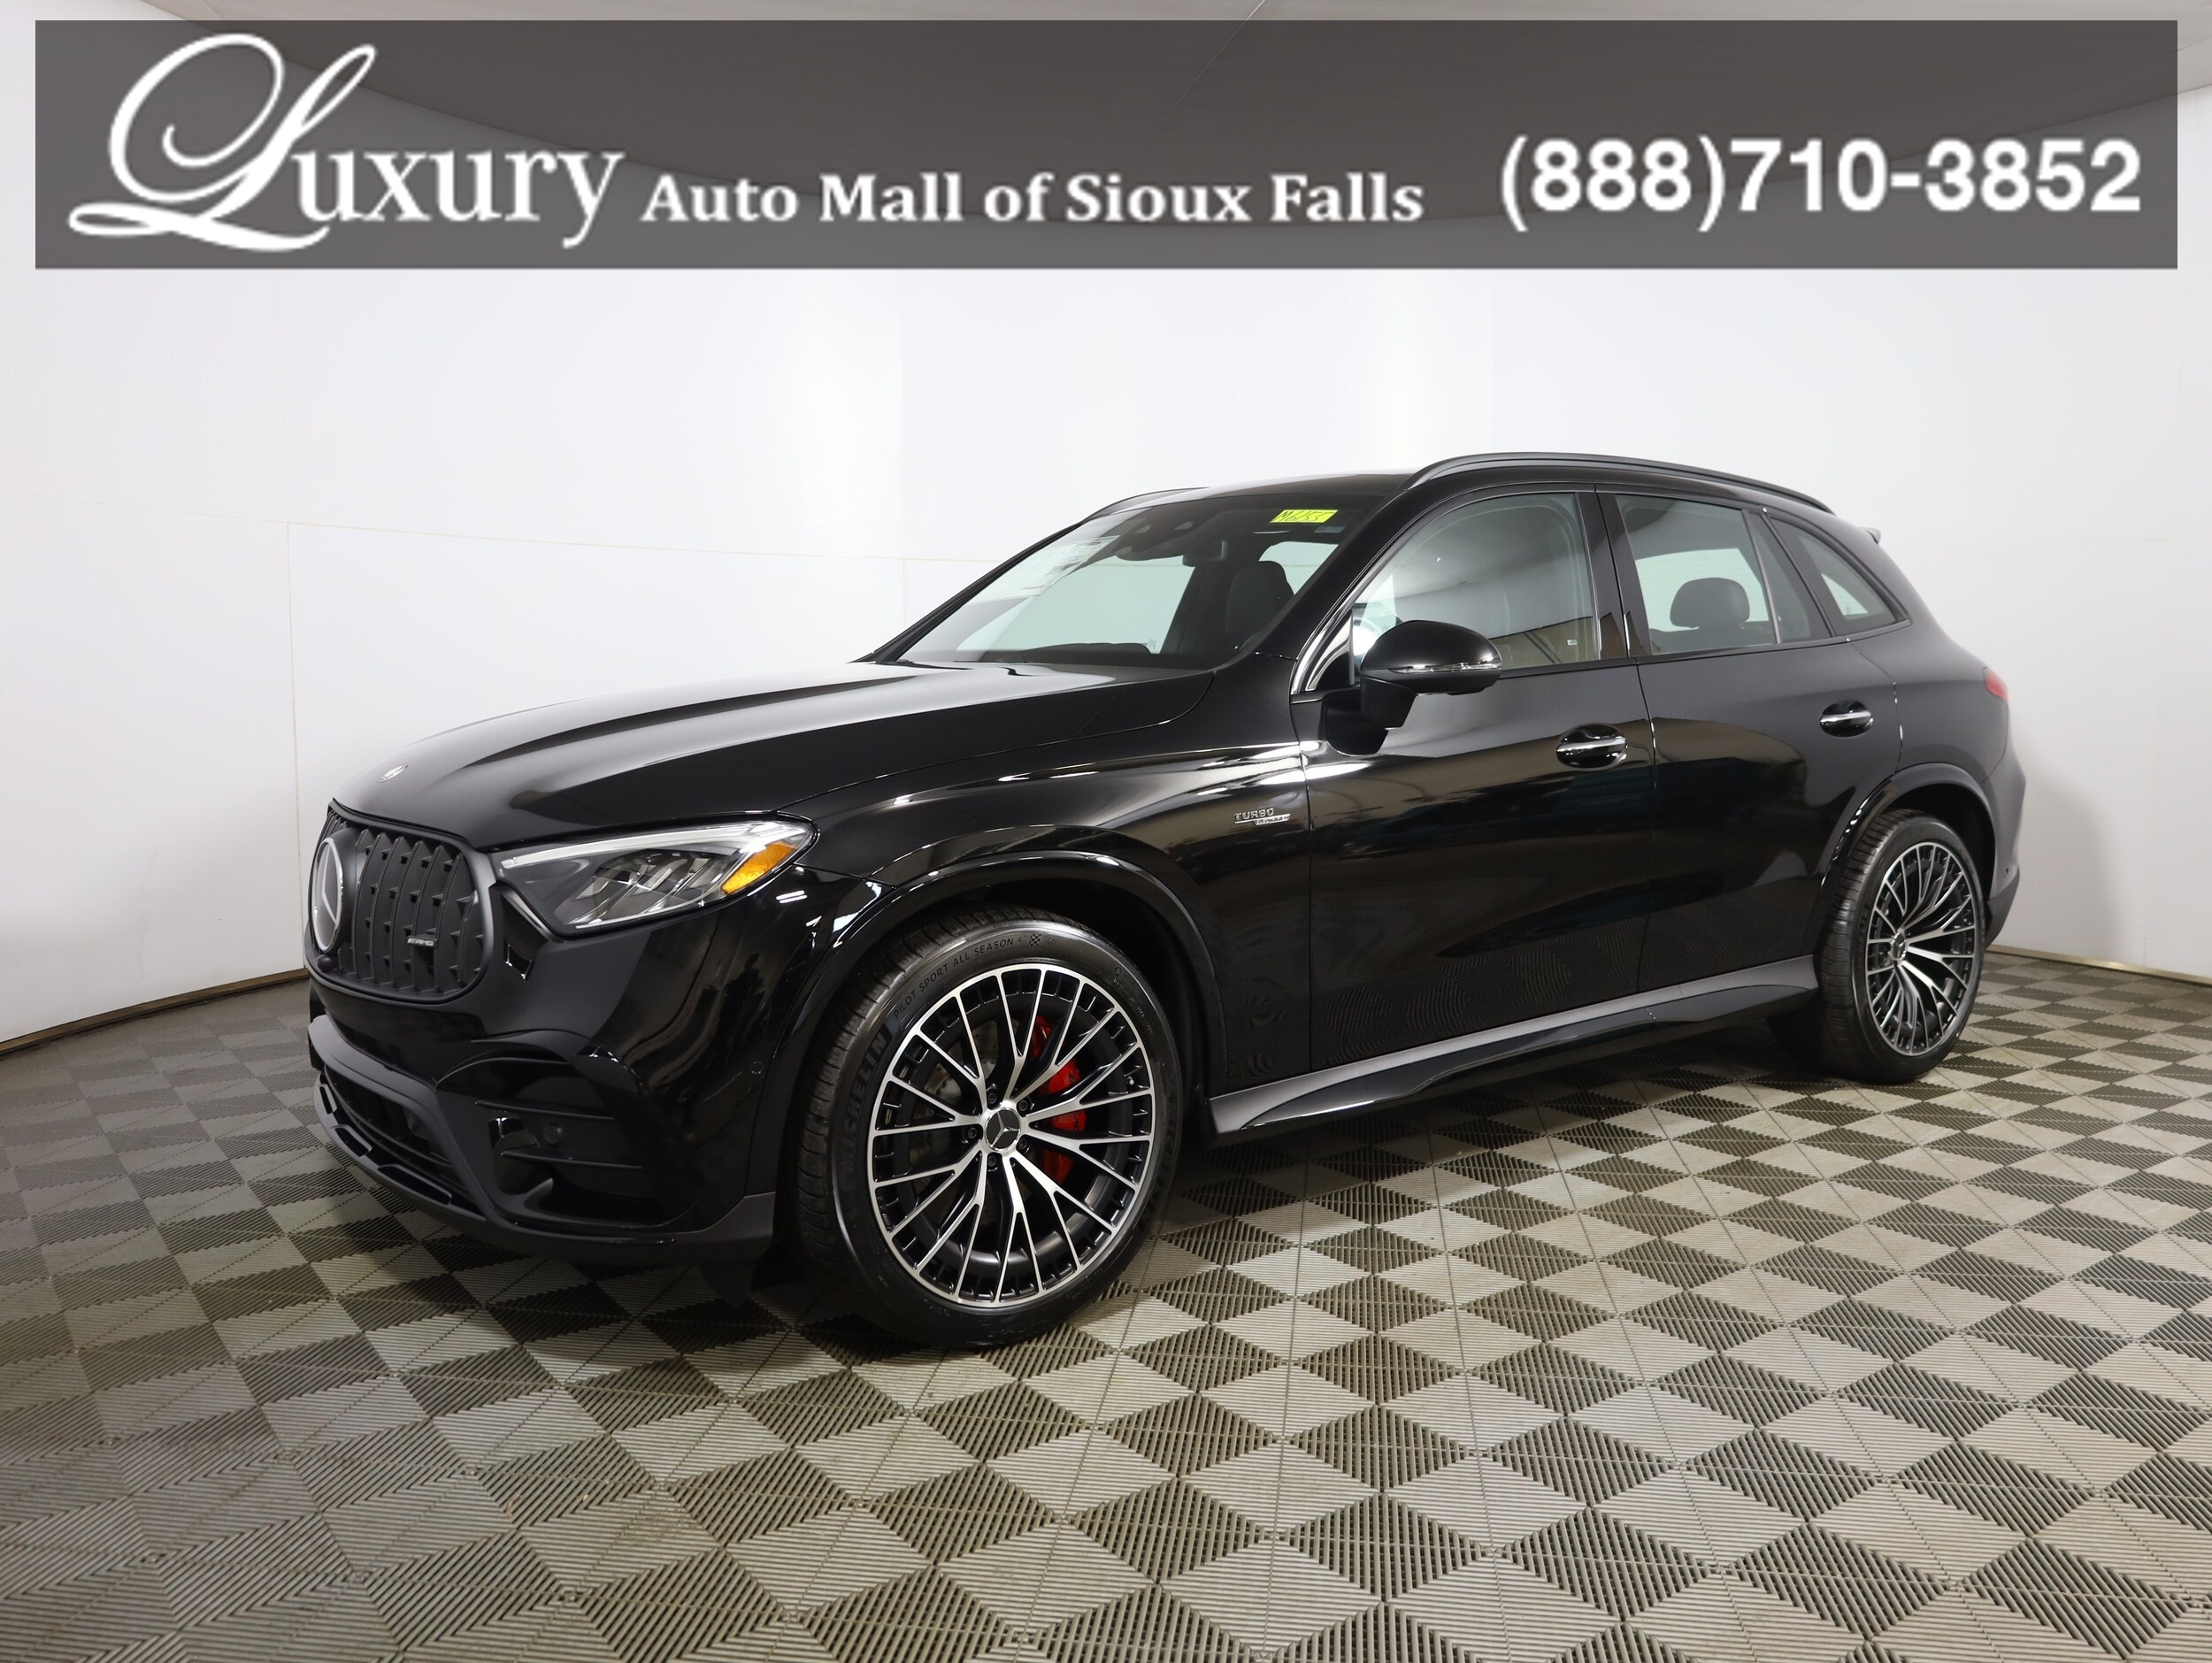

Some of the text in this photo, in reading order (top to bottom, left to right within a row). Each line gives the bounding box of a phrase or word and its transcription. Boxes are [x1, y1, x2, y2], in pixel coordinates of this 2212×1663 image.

[1233, 808, 1274, 821] TURBO
[894, 990, 917, 1019] PILOT
[919, 963, 949, 992] SPORT
[952, 951, 972, 968] ALL
[974, 937, 1015, 957] SEASON
